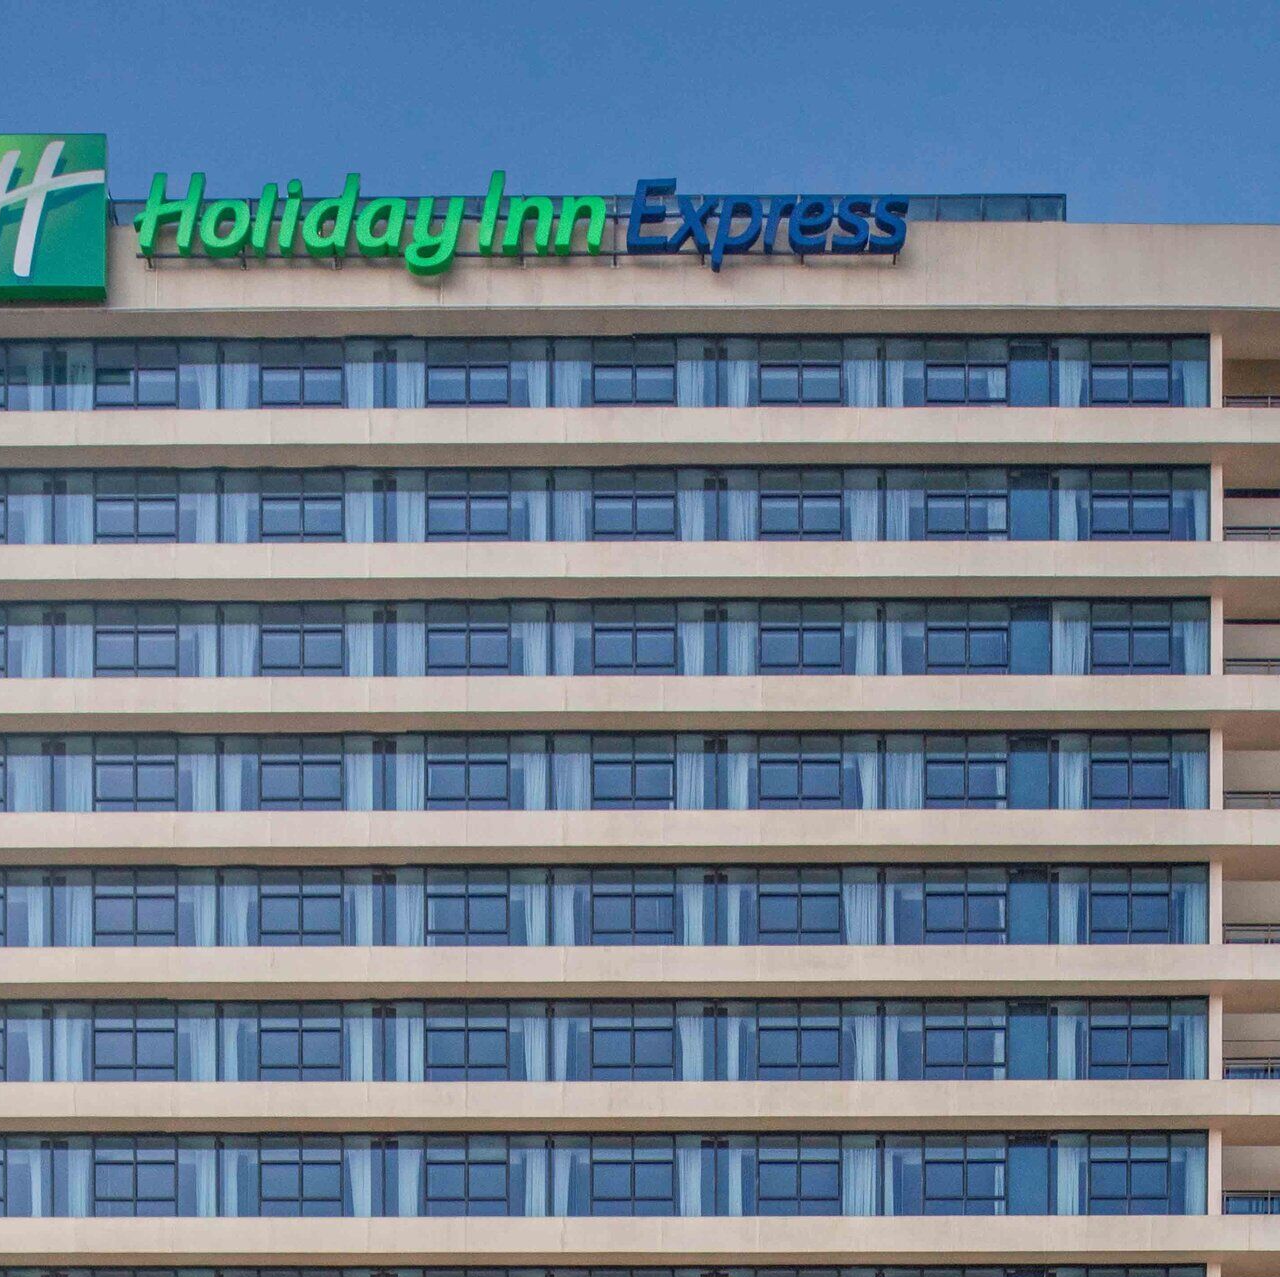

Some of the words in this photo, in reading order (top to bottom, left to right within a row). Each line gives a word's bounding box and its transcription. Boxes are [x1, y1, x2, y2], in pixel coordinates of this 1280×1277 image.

[134, 173, 464, 276] Holiday
[479, 170, 606, 256] Inn
[627, 178, 910, 273] Express
